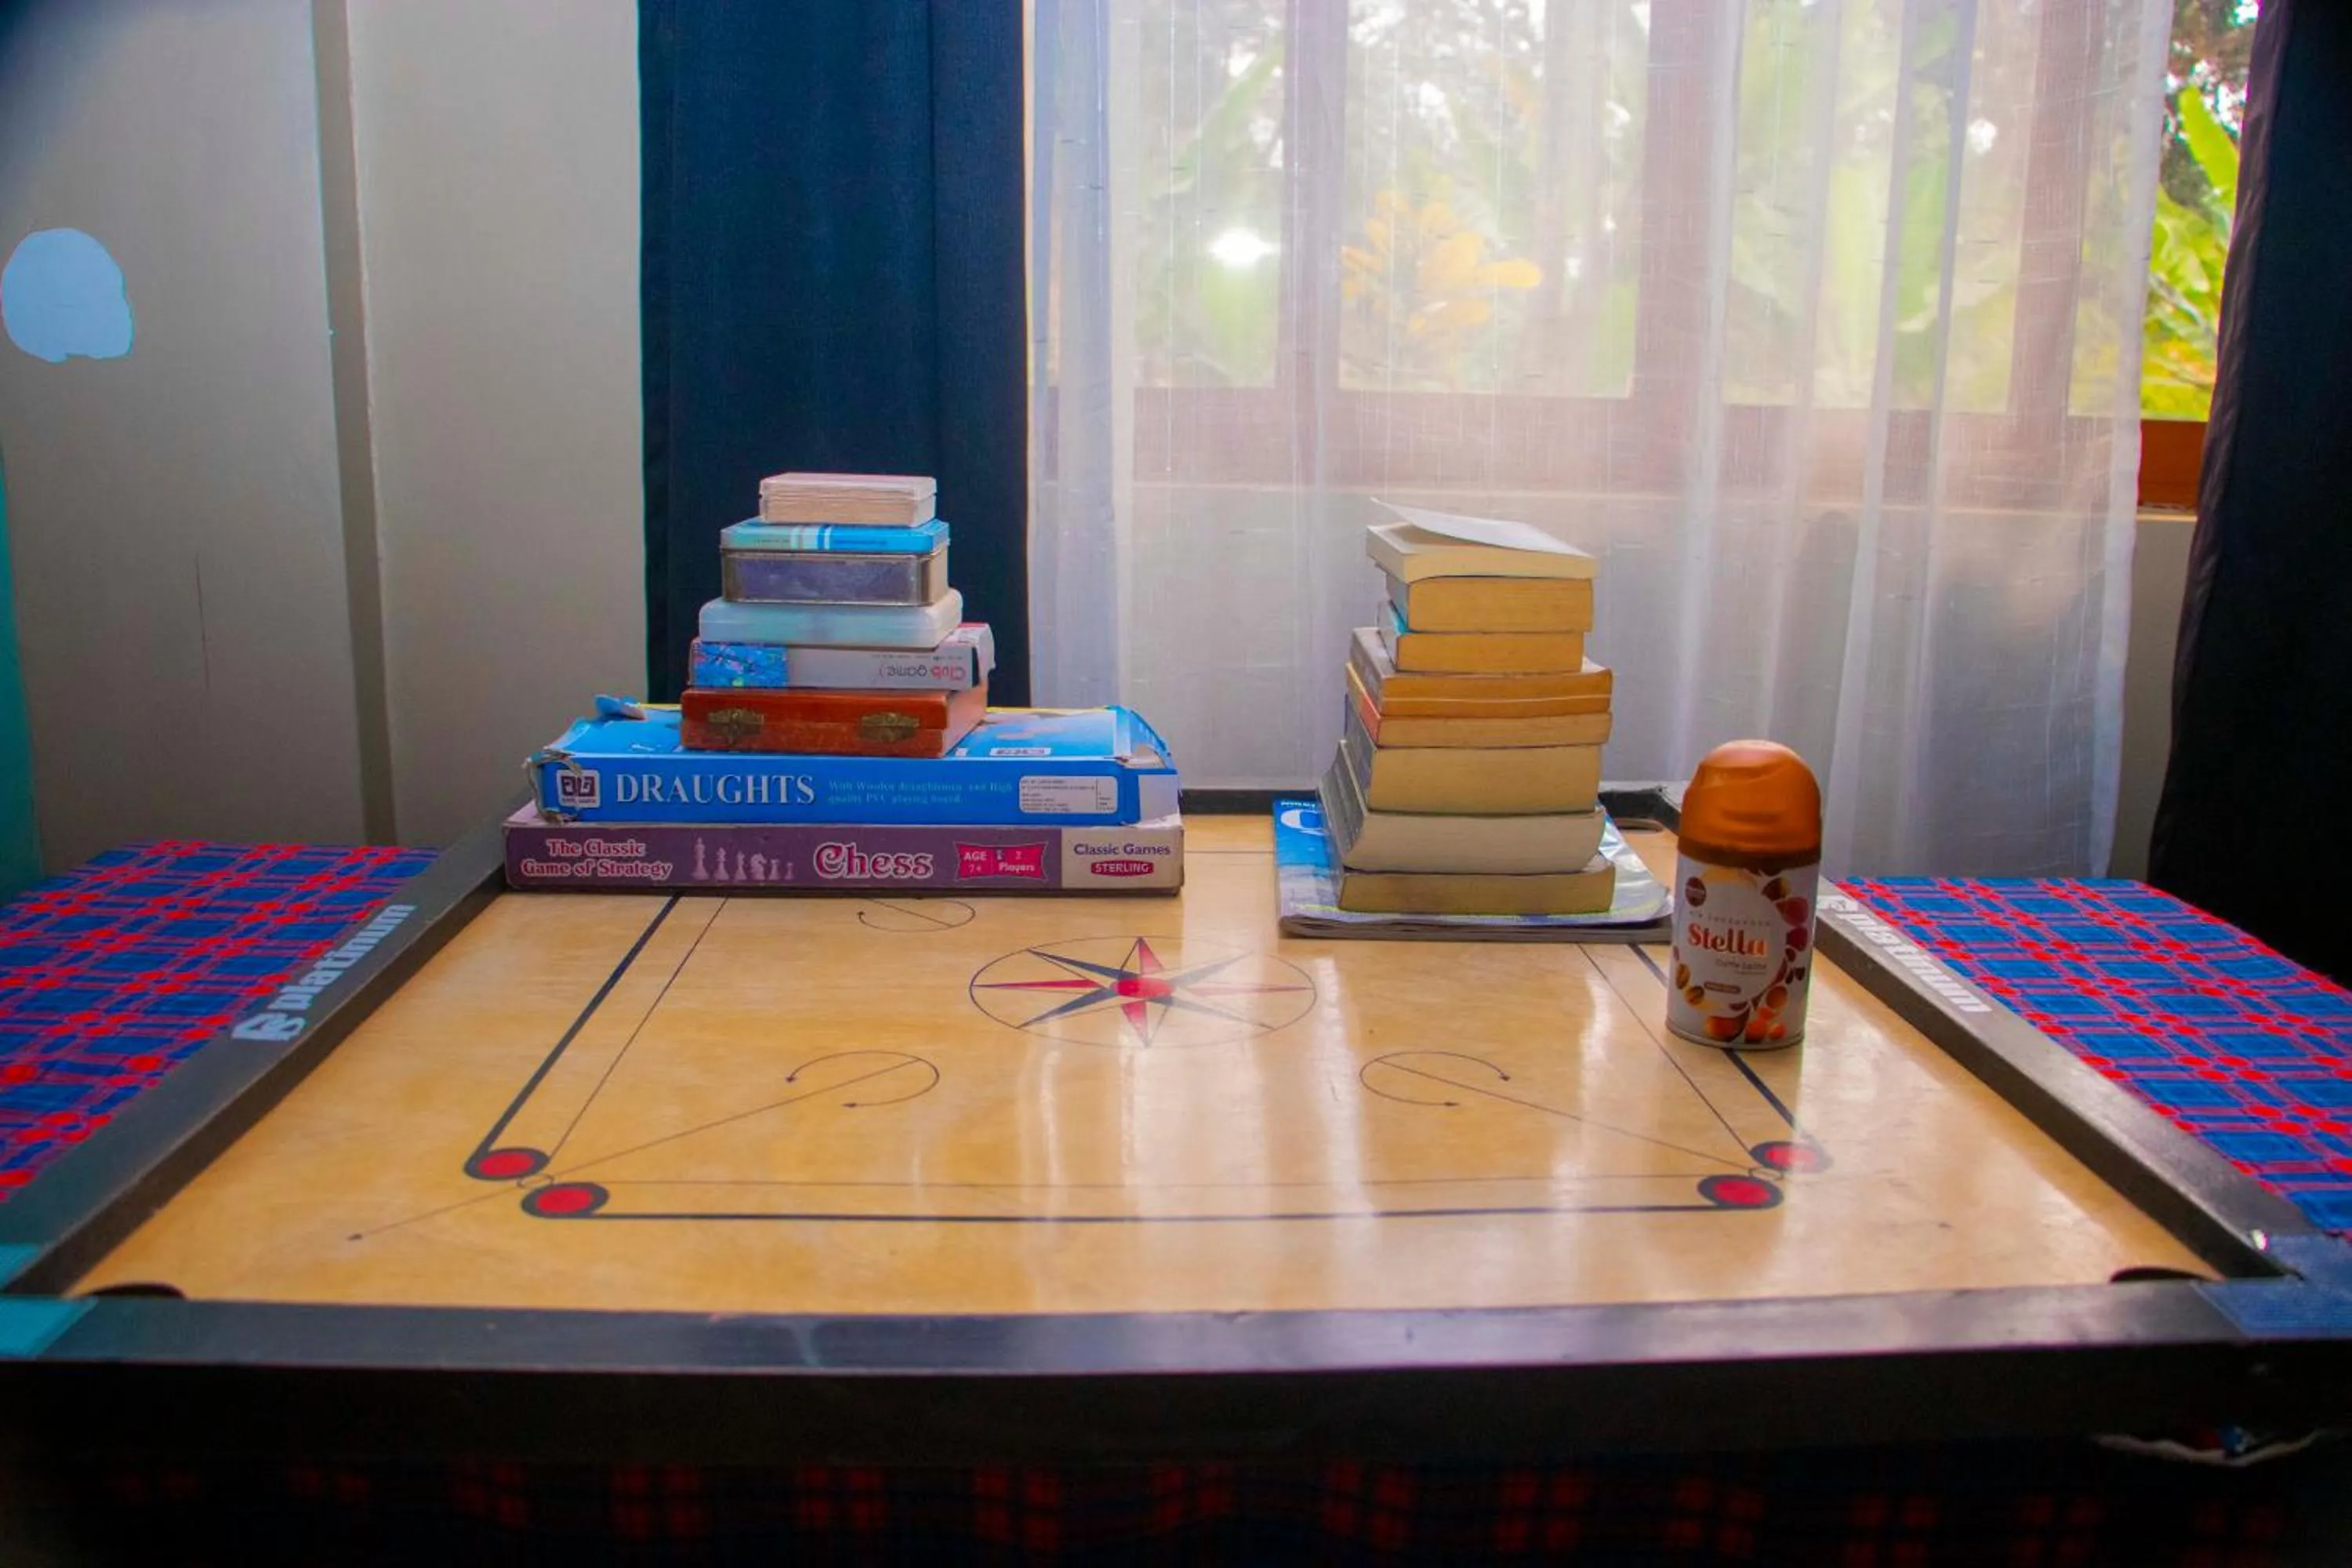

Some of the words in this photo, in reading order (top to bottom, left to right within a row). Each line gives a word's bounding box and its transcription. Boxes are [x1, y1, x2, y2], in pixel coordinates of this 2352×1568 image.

[616, 773, 816, 805] DRAUGHTS
[546, 839, 583, 856] The
[584, 838, 646, 857] Classic
[963, 851, 988, 862] AGE
[1073, 843, 1119, 855] Classic
[1123, 843, 1171, 856] Games
[521, 858, 572, 877] Game
[574, 858, 596, 877] of
[597, 858, 673, 880] Strategy
[815, 842, 933, 879] Chess
[1095, 863, 1150, 873] STERLING
[1688, 923, 1769, 956] Stella
[267, 904, 418, 1010] platinum
